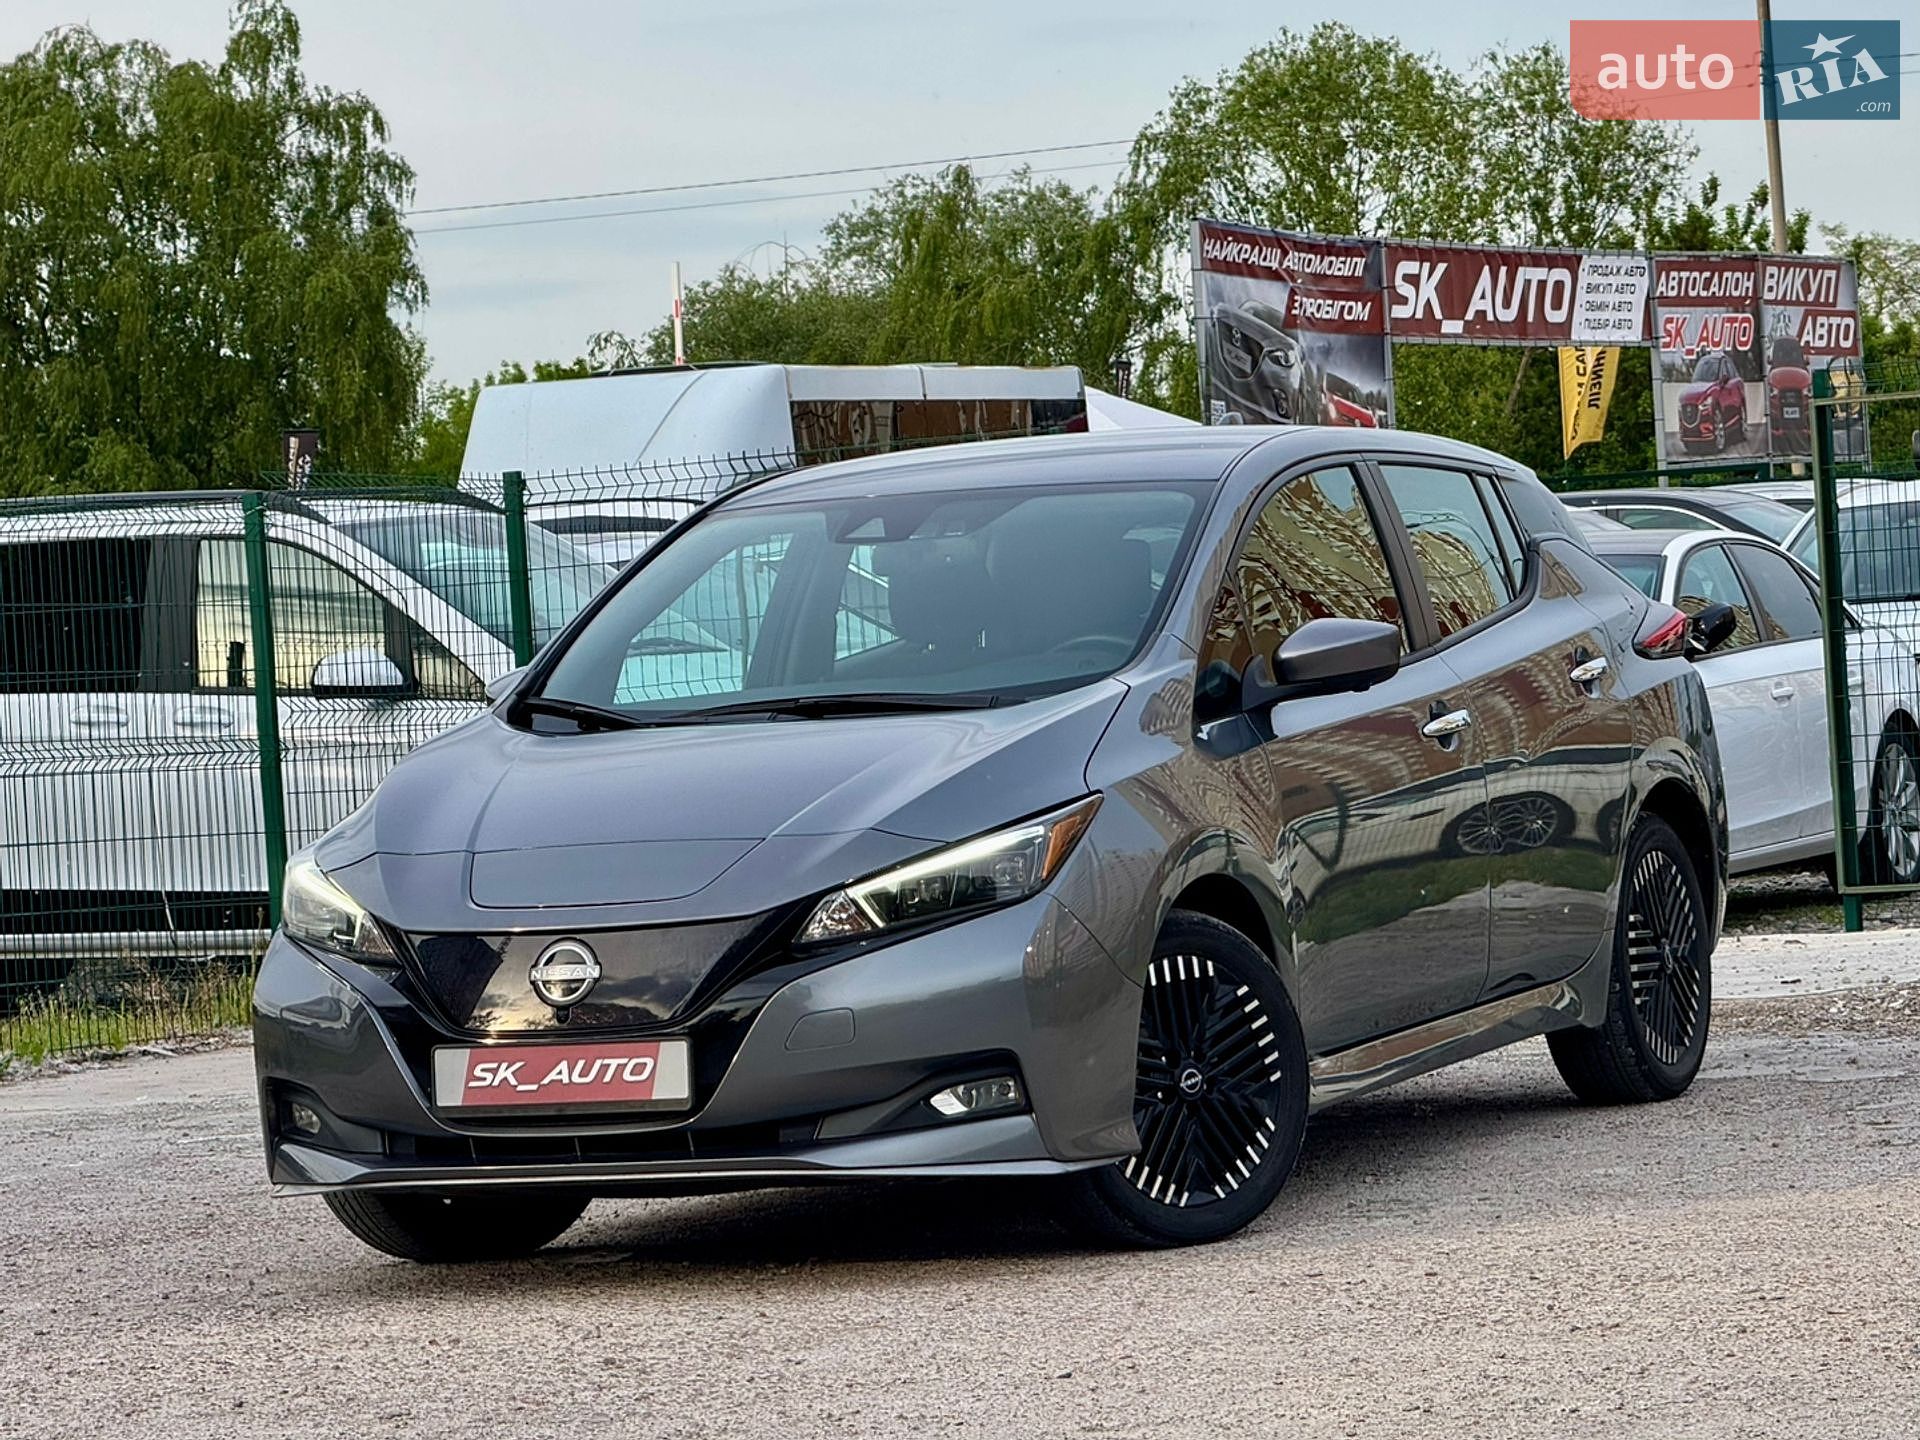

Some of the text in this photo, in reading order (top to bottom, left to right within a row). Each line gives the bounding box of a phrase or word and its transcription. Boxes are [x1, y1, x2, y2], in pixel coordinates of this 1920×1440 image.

[1203, 236, 1281, 270] НАЙКРАЩІ
[1587, 264, 1646, 277] ПРОДАЖ АВТО
[1656, 270, 1755, 298] АВТОСАЛОН
[1763, 266, 1838, 303] ВИКУП
[1391, 260, 1572, 334] SK_AUTO
[1585, 282, 1636, 294] ВИКУП АВТО
[1585, 300, 1633, 312] ОБМІН АВТО
[1611, 318, 1633, 330] АВТО
[1660, 313, 1755, 359] SK_AUTO
[1800, 315, 1855, 349] АВТО
[531, 965, 600, 979] NISSAN
[468, 1057, 655, 1091] SK_AUTO
